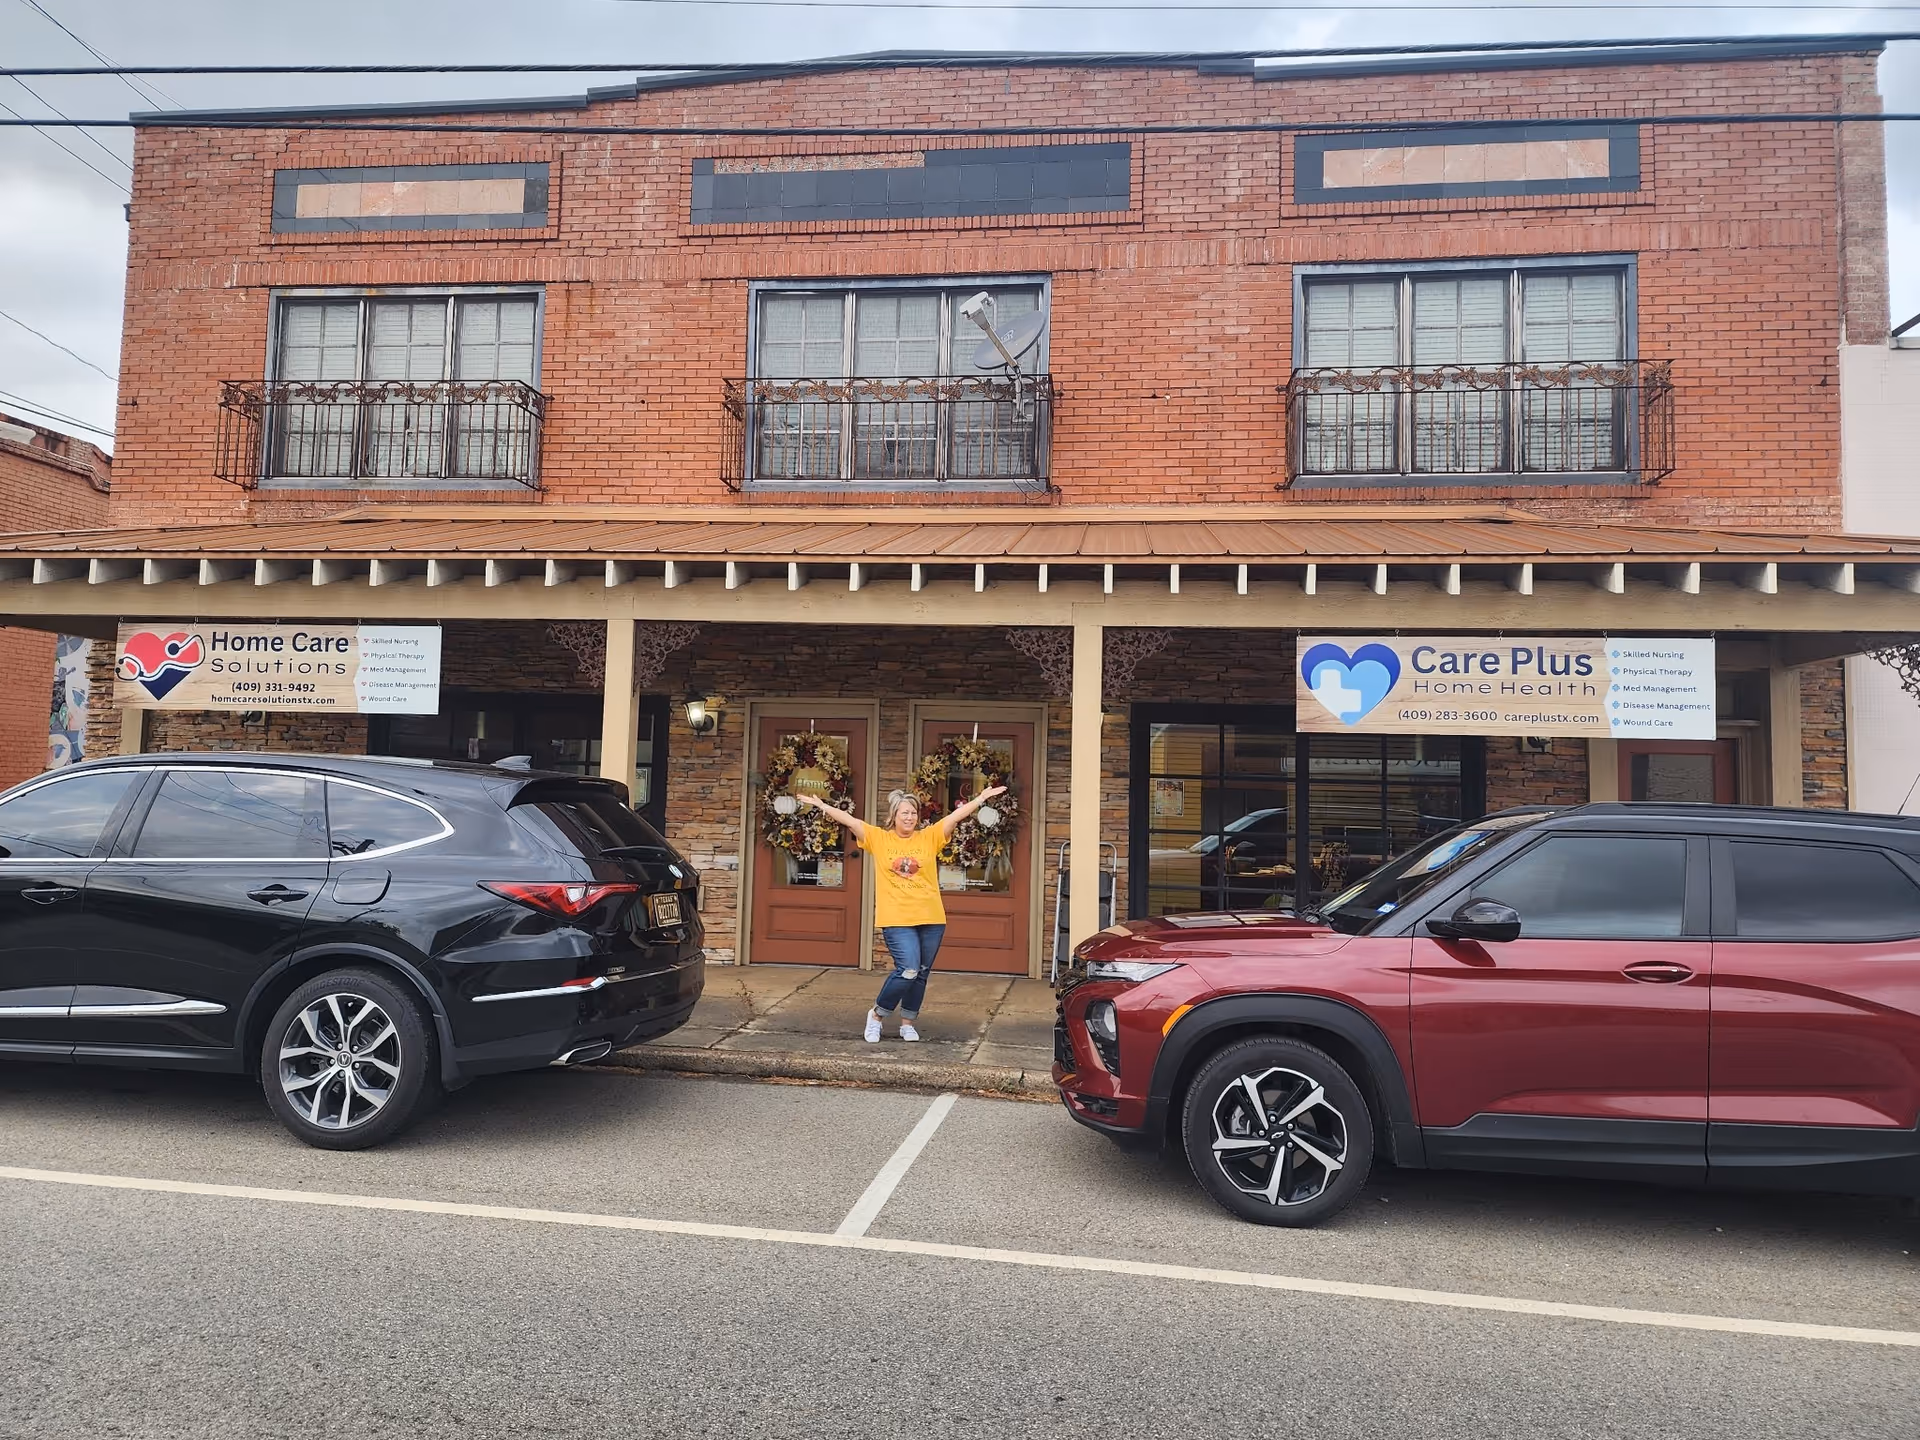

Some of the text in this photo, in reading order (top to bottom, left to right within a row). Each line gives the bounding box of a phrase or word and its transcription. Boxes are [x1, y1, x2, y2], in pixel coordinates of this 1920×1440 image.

[211, 631, 349, 653] Home Care
[394, 638, 419, 646] Nursing
[370, 652, 425, 661] Physical Therapy
[1623, 650, 1685, 660] Skilled Nursing
[211, 657, 346, 675] Solutions
[1411, 645, 1594, 677] Care Plus
[1623, 667, 1693, 677] Physical Therapy
[231, 682, 316, 693] (409) 331-9492
[395, 682, 437, 690] Management
[1414, 680, 1596, 696] Home Health
[1643, 685, 1698, 694] Management
[211, 694, 335, 704] homecaresolutionstx.com
[1656, 702, 1711, 711] Management
[1398, 710, 1600, 724] (409) 283-3600 careplustx.com
[1654, 719, 1673, 727] Care
